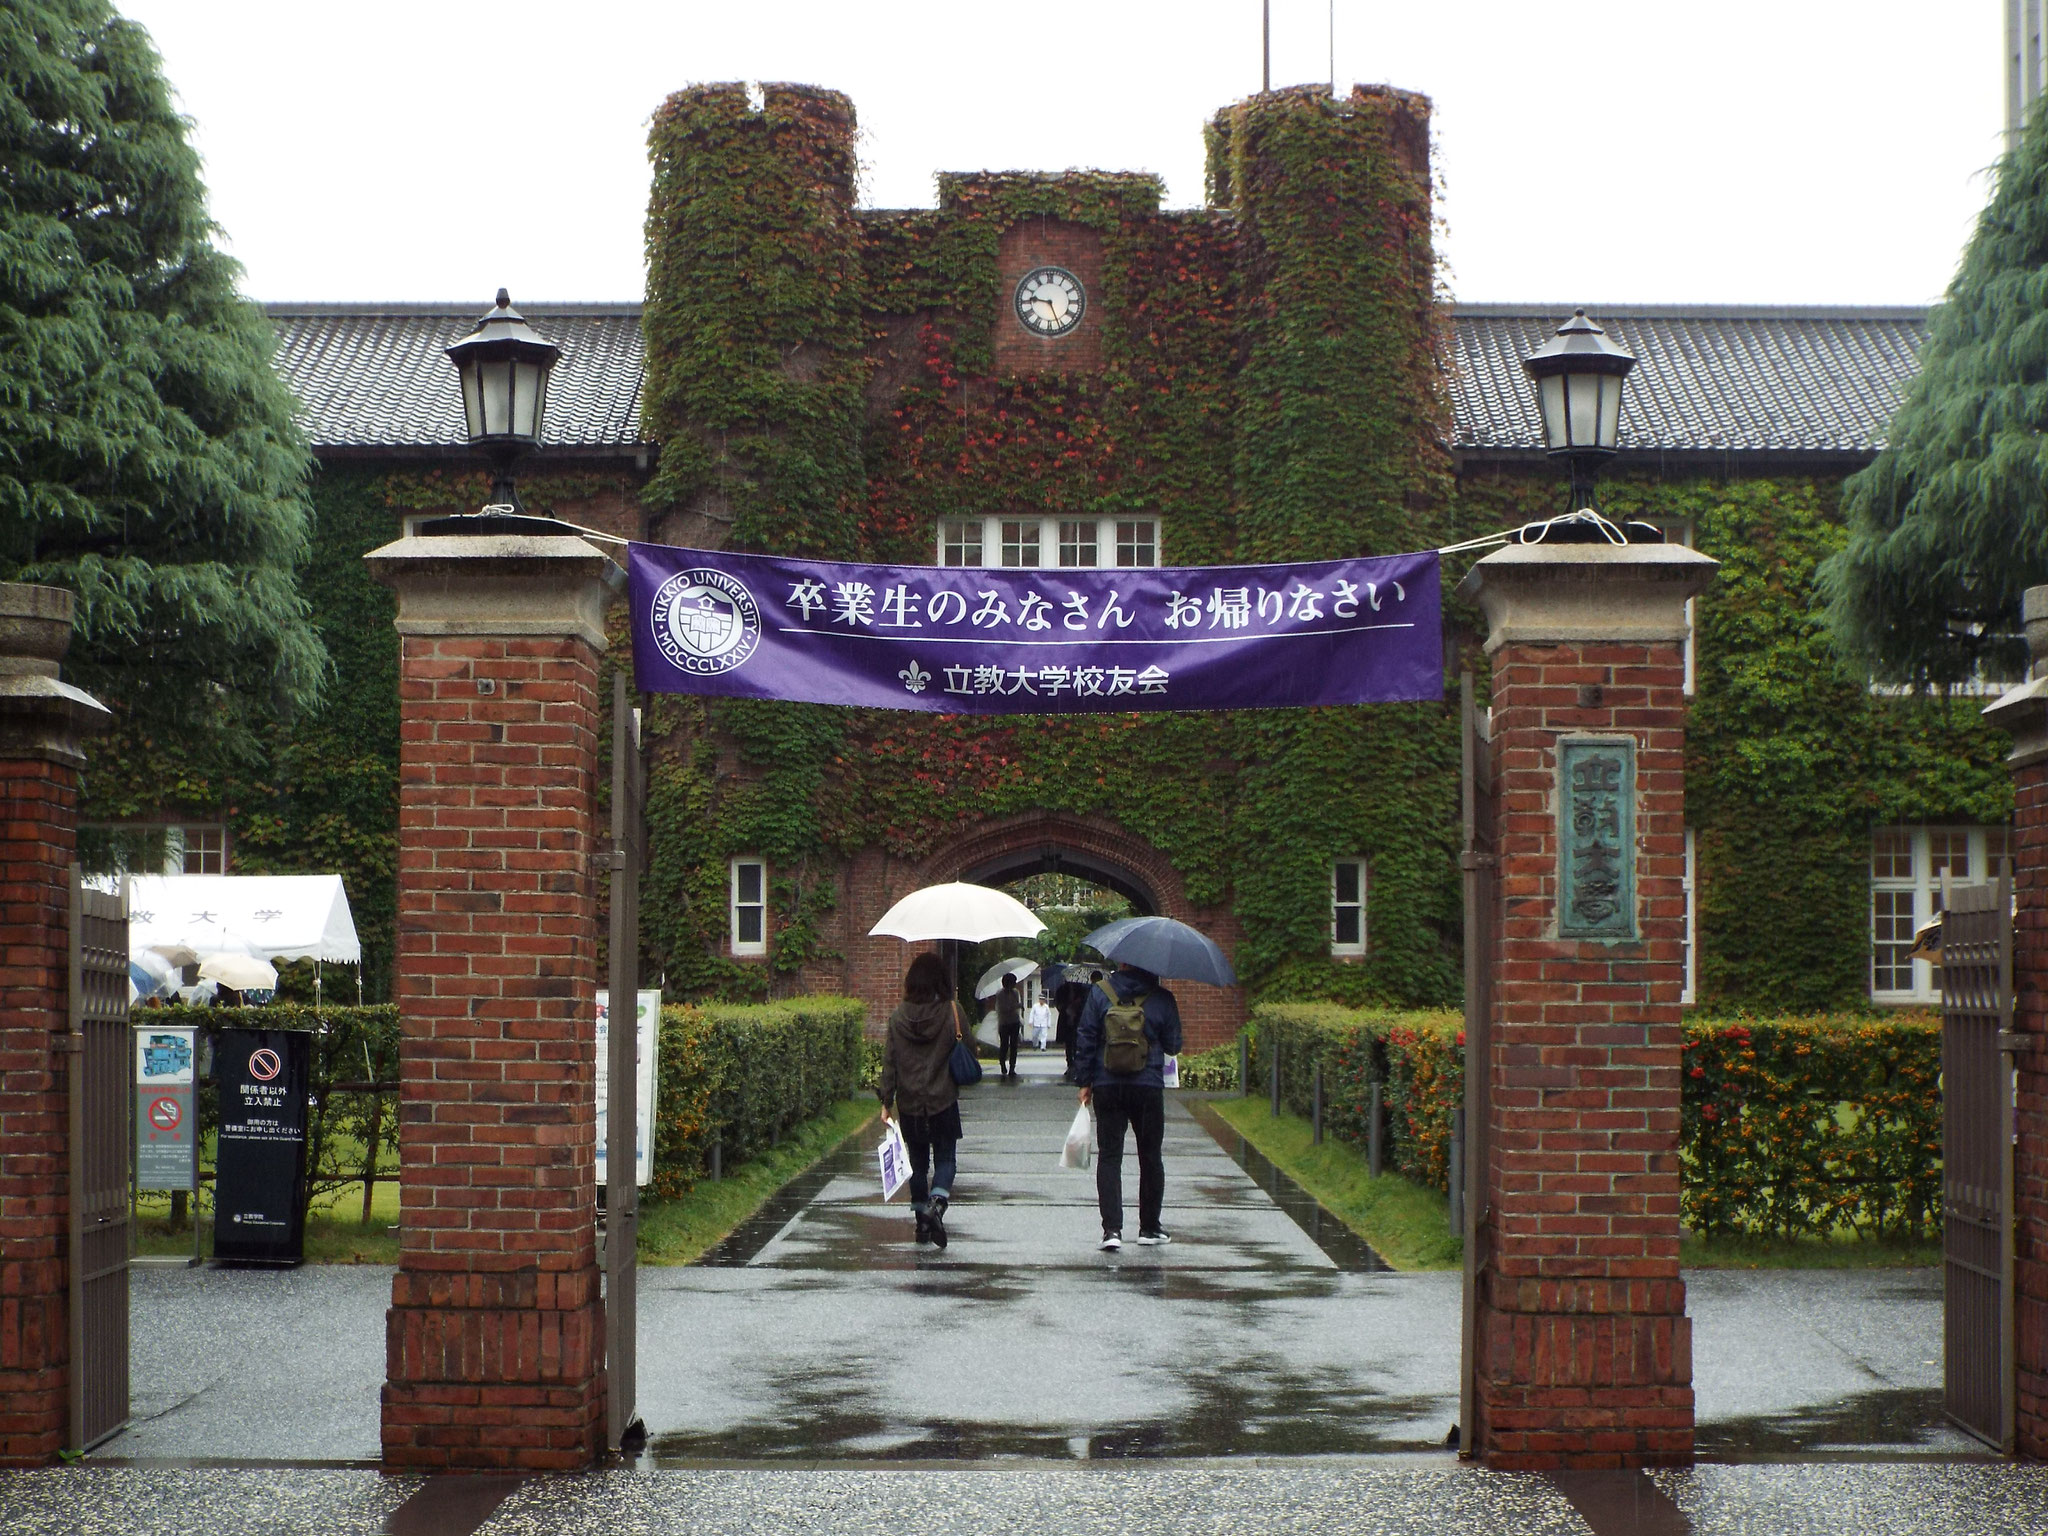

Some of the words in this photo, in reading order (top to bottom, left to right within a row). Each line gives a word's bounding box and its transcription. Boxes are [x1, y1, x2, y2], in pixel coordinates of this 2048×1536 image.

[655, 576, 690, 621] RIKKYO
[694, 572, 757, 635] UNIVERSITY
[786, 578, 1135, 631] 卒業生のみなさん
[1164, 579, 1405, 630] お帰りなさい
[658, 631, 751, 671] MDCCCLXXIV
[943, 664, 1170, 697] 立教大学校友会
[240, 1084, 287, 1096] 関係者以外
[244, 1096, 282, 1107] 立入禁止
